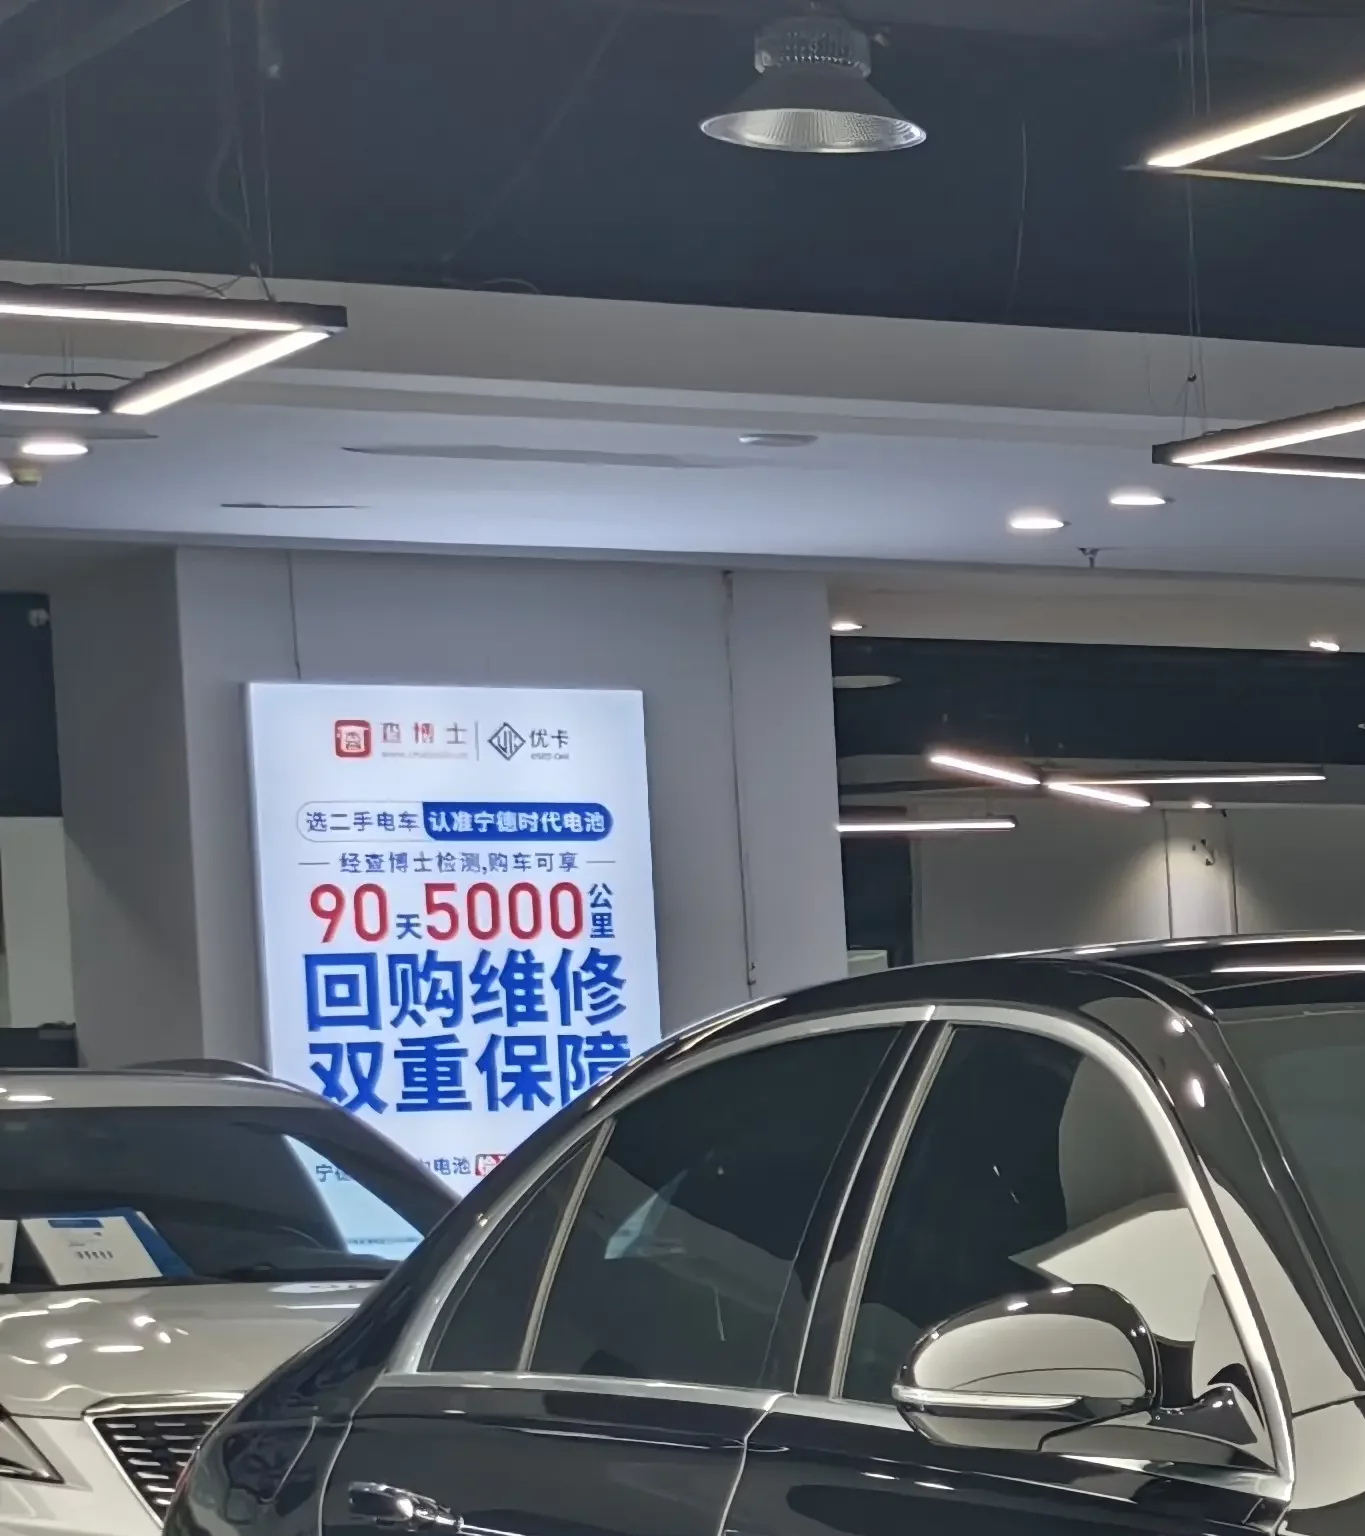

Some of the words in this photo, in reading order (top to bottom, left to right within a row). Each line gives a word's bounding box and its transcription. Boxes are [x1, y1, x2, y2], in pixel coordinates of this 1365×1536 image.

[306, 811, 420, 833] 选二手电车
[428, 811, 606, 833] 认准宁德时代电池
[304, 948, 627, 1032] 回购维修
[308, 1031, 631, 1114] 双重保障
